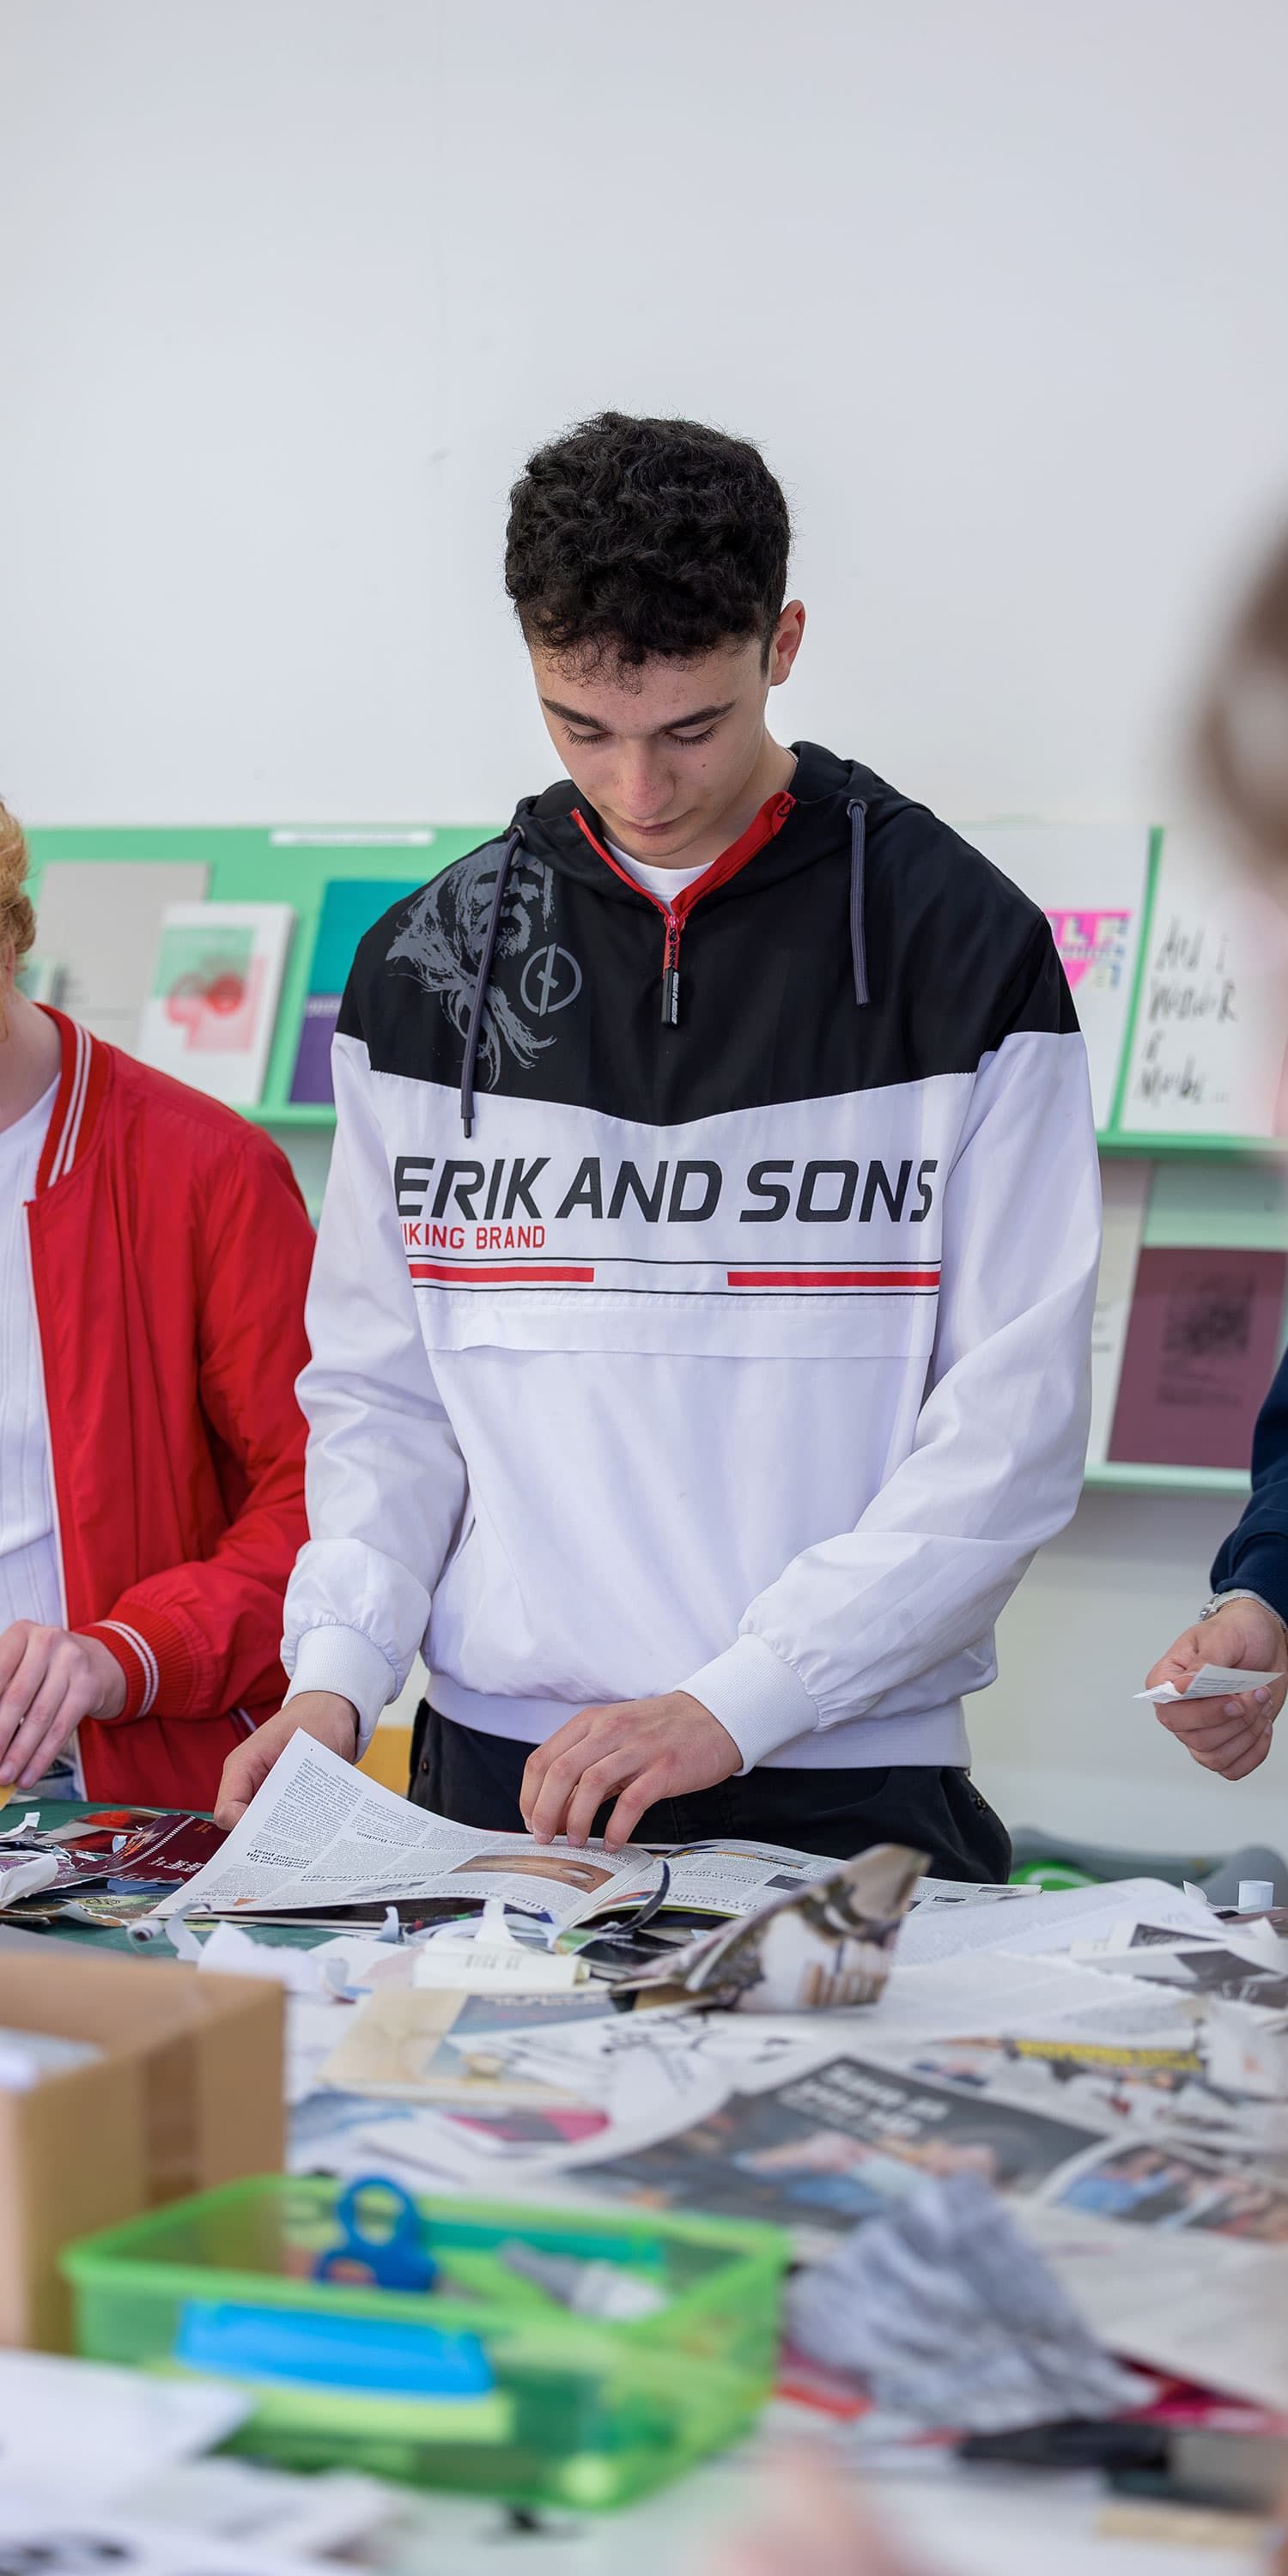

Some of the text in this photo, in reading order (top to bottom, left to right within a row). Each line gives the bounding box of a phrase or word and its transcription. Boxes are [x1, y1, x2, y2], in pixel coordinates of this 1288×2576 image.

[394, 1157, 938, 1223] ERIK AND SONS
[401, 1223, 545, 1250] IKING BRAND
